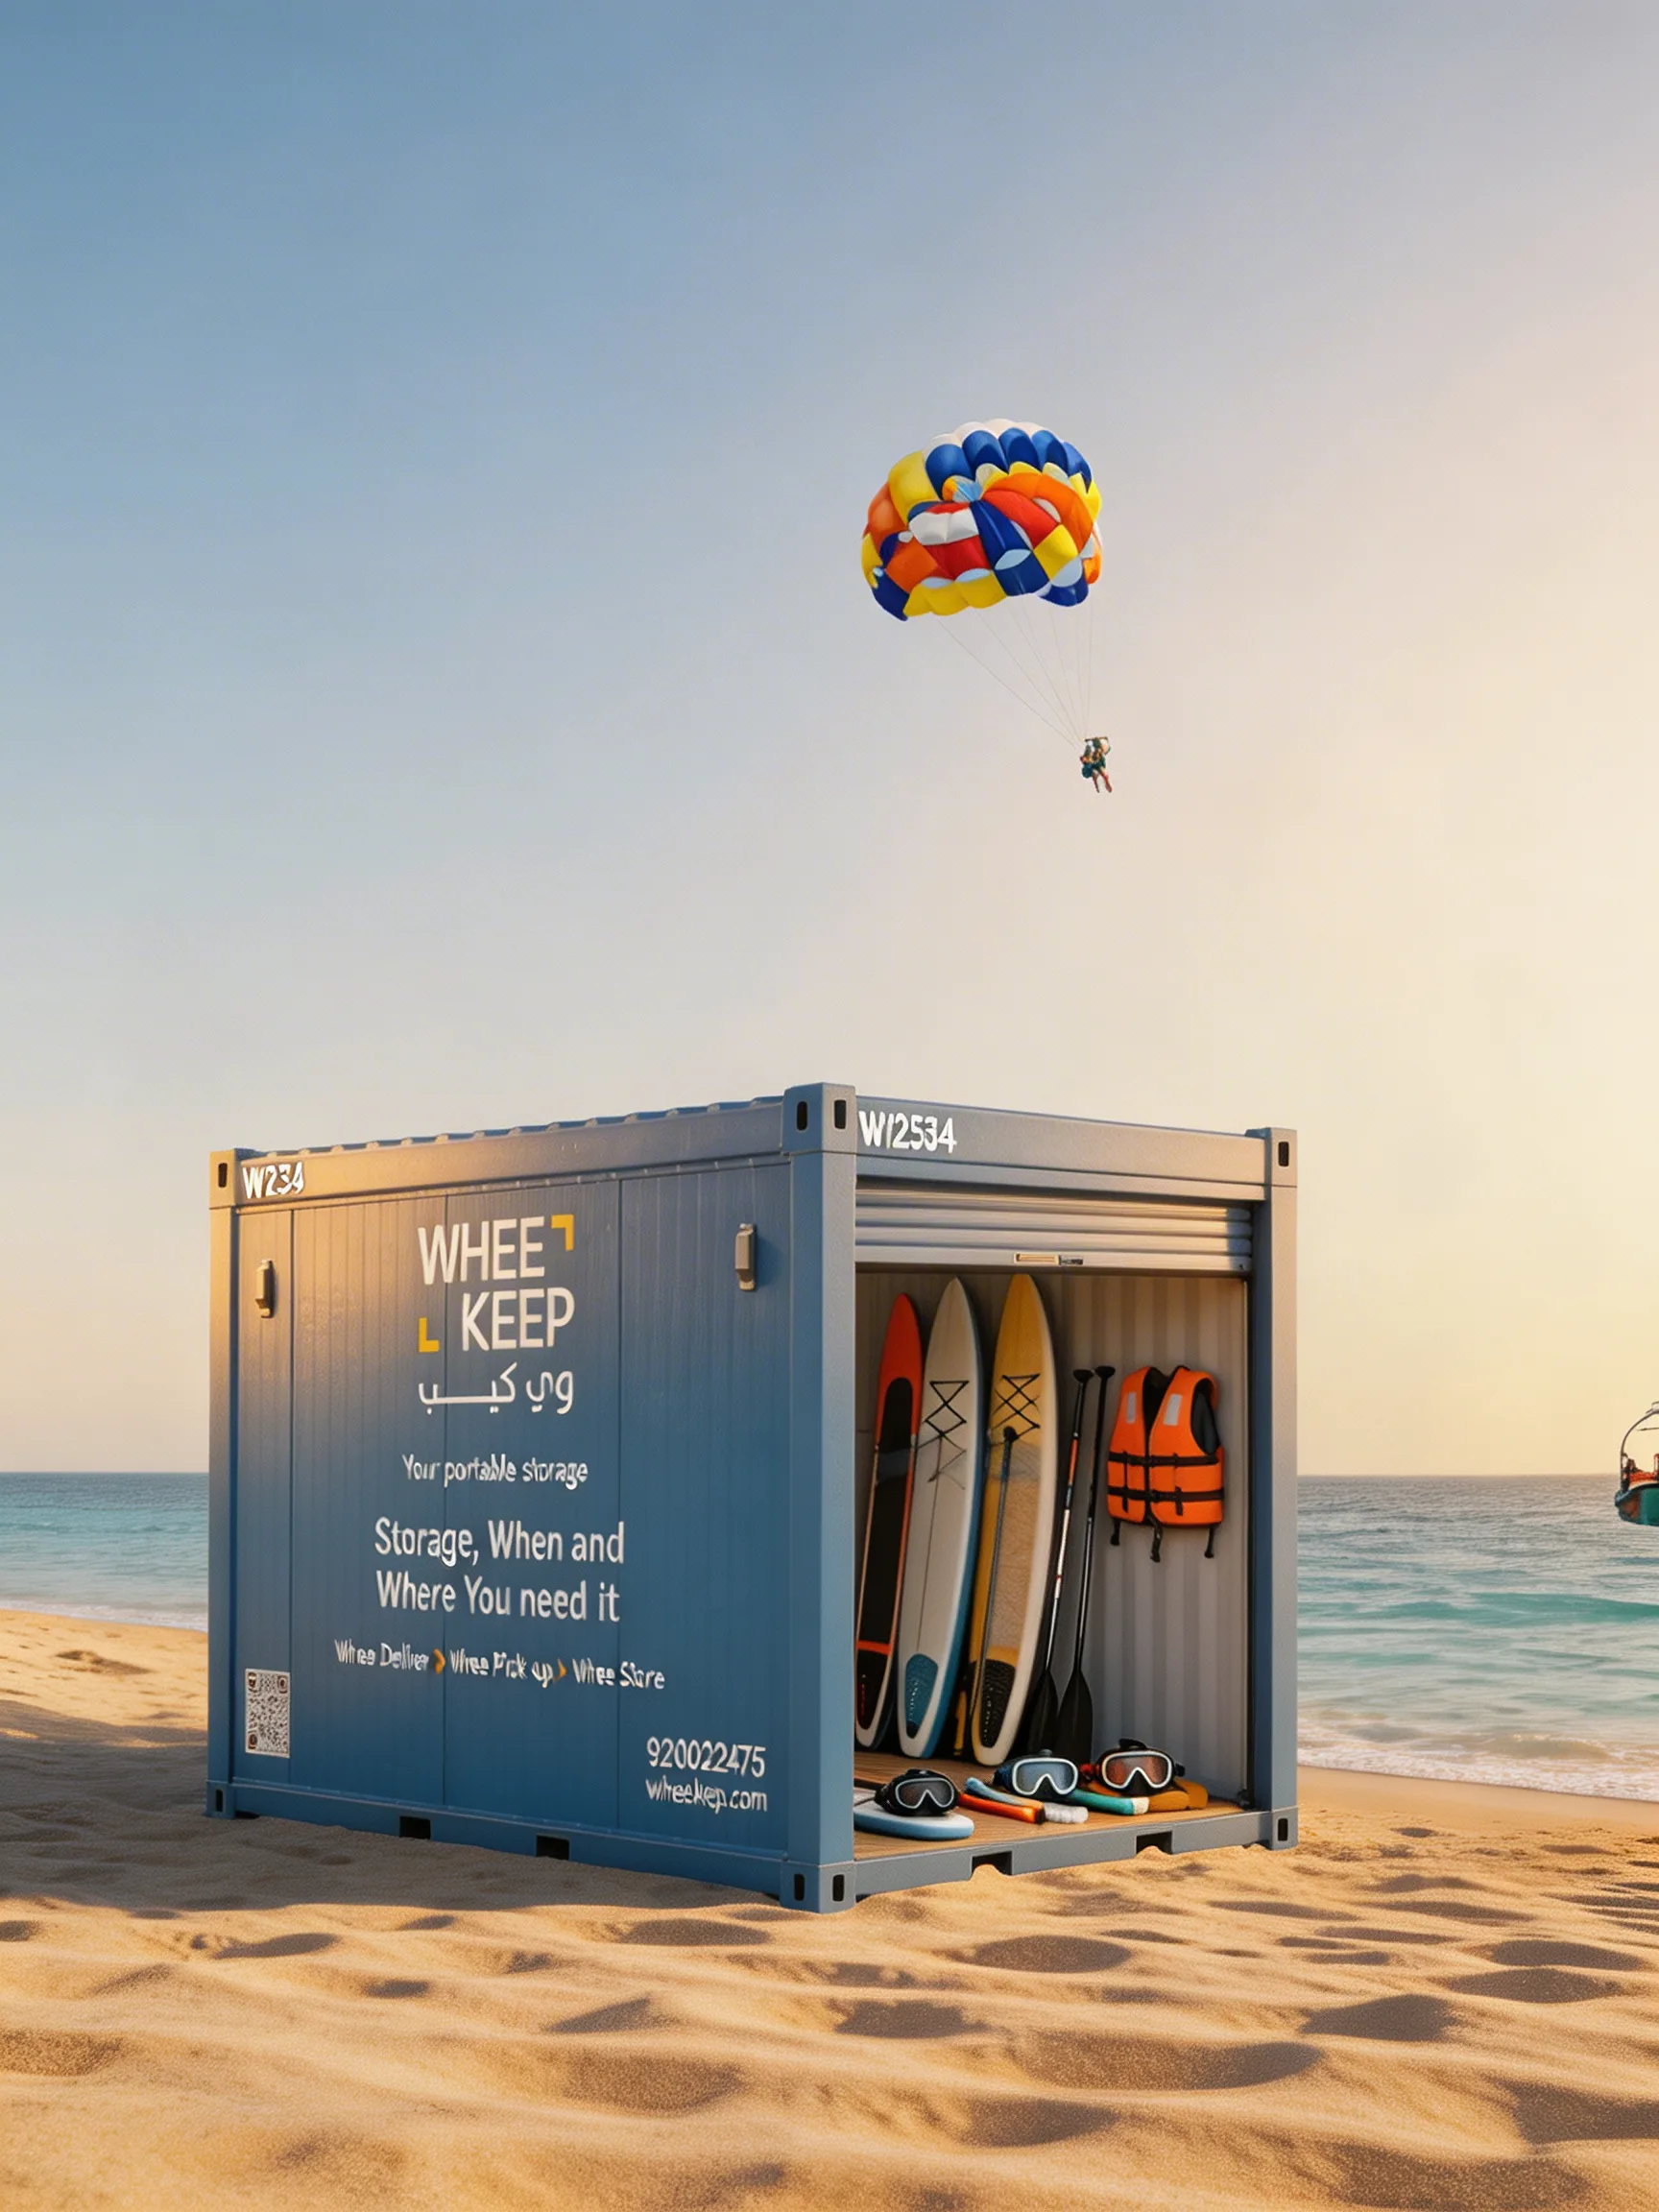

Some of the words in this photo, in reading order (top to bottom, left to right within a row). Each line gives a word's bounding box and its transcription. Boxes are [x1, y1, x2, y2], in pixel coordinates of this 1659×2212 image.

[242, 1161, 304, 1199] W234
[418, 1215, 545, 1286] WHEE
[462, 1286, 575, 1352] KEEP
[401, 1454, 441, 1480] Your
[444, 1453, 517, 1488] portable
[521, 1456, 589, 1490] storage
[374, 1516, 479, 1567] Storage,
[487, 1519, 563, 1562] When
[570, 1520, 624, 1564] and
[375, 1570, 456, 1613] Where
[463, 1575, 512, 1615] You
[519, 1579, 587, 1621] need
[598, 1581, 620, 1623] it
[646, 1736, 766, 1778] 920022475
